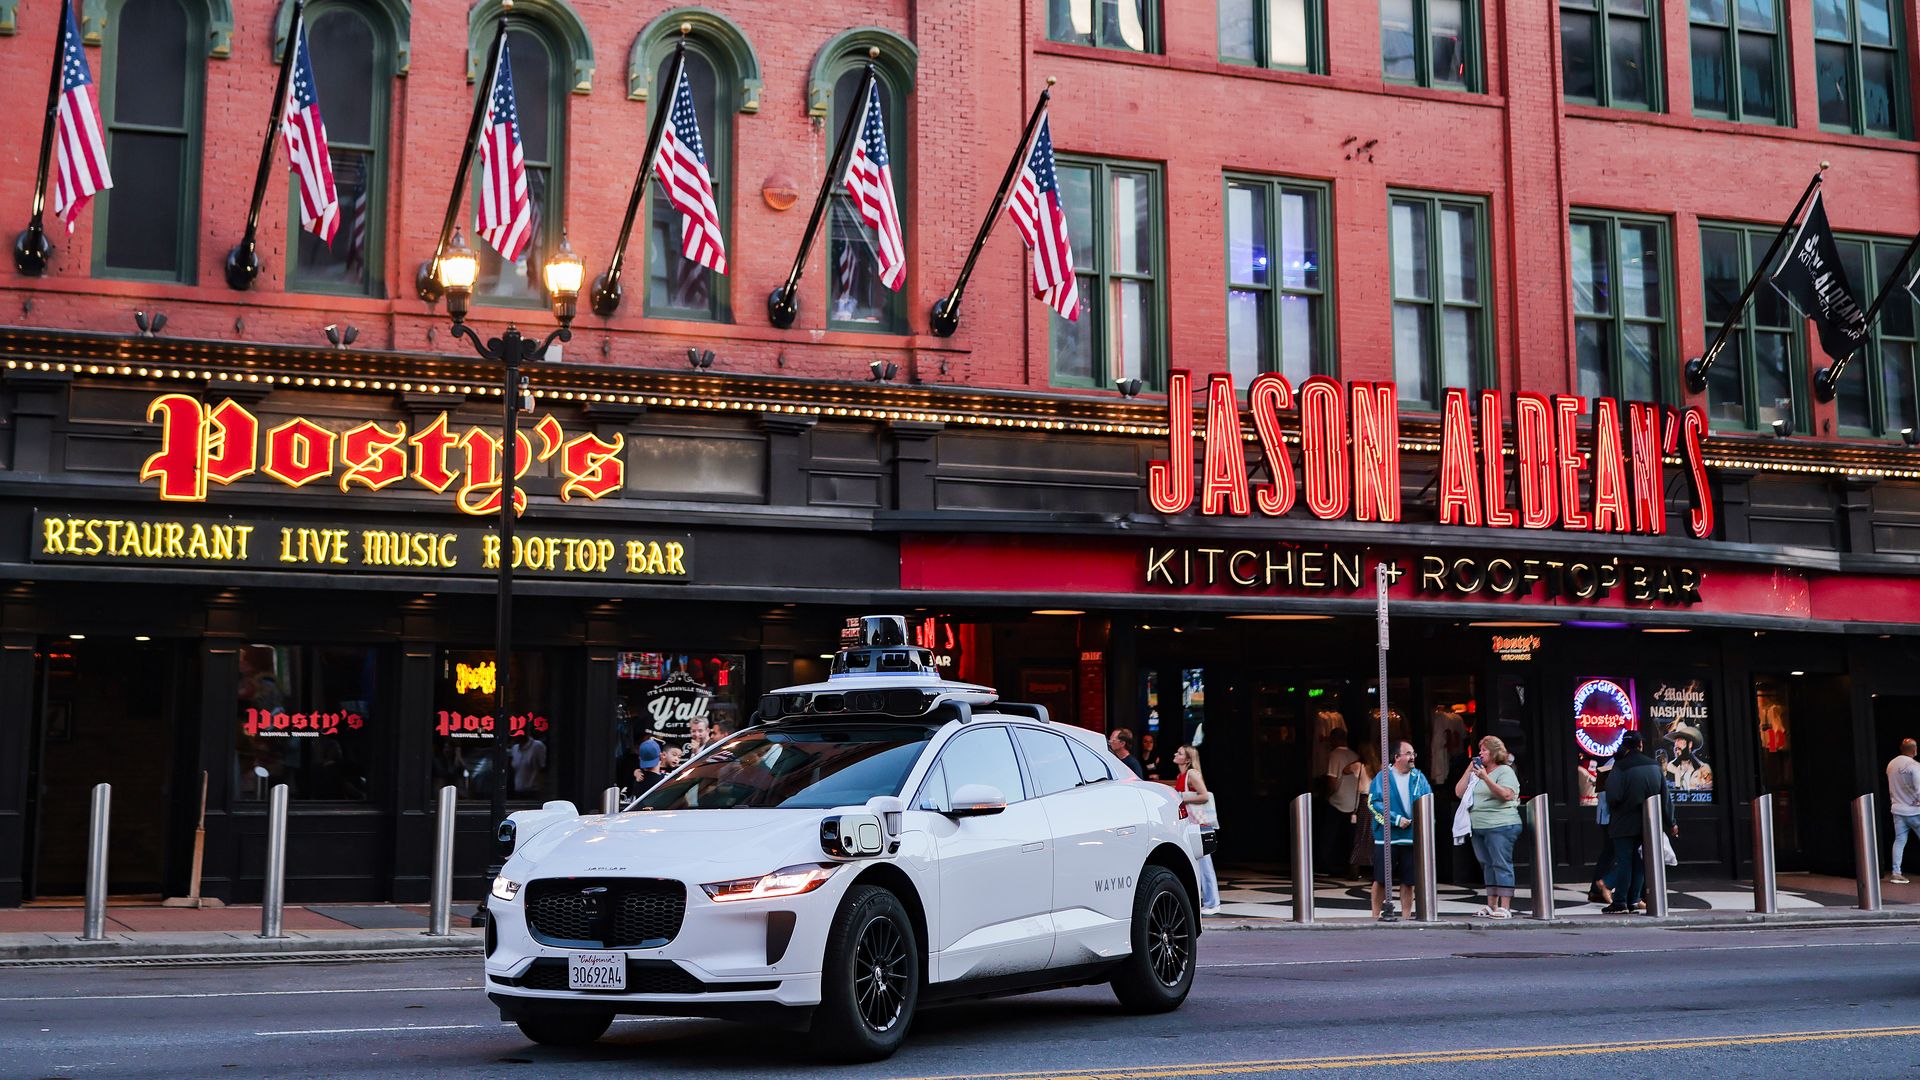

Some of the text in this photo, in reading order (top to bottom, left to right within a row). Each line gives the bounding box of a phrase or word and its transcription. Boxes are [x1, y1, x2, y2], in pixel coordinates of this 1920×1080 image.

[139, 393, 626, 518] Posty's
[1149, 368, 1715, 540] JASON ALDEAN'S
[42, 517, 255, 562] RESTAURANT
[279, 526, 350, 565] LIVE
[361, 530, 458, 569] MUSIC
[625, 540, 687, 576] BAR
[1146, 546, 1363, 592] KITCHEN
[1422, 554, 1622, 602] ROOFTOP
[1632, 564, 1702, 604] BAR
[1597, 681, 1618, 696] GIFT
[1615, 691, 1633, 721] SHOP
[1663, 686, 1705, 702] Malone
[243, 708, 364, 736] Posty's
[435, 710, 549, 738] Posy's
[647, 695, 710, 731] Y'all
[1580, 713, 1626, 728] Posty's
[1650, 705, 1708, 719] NASHVILLE
[1095, 875, 1133, 893] WAYMO
[572, 966, 622, 985] 30692A4
